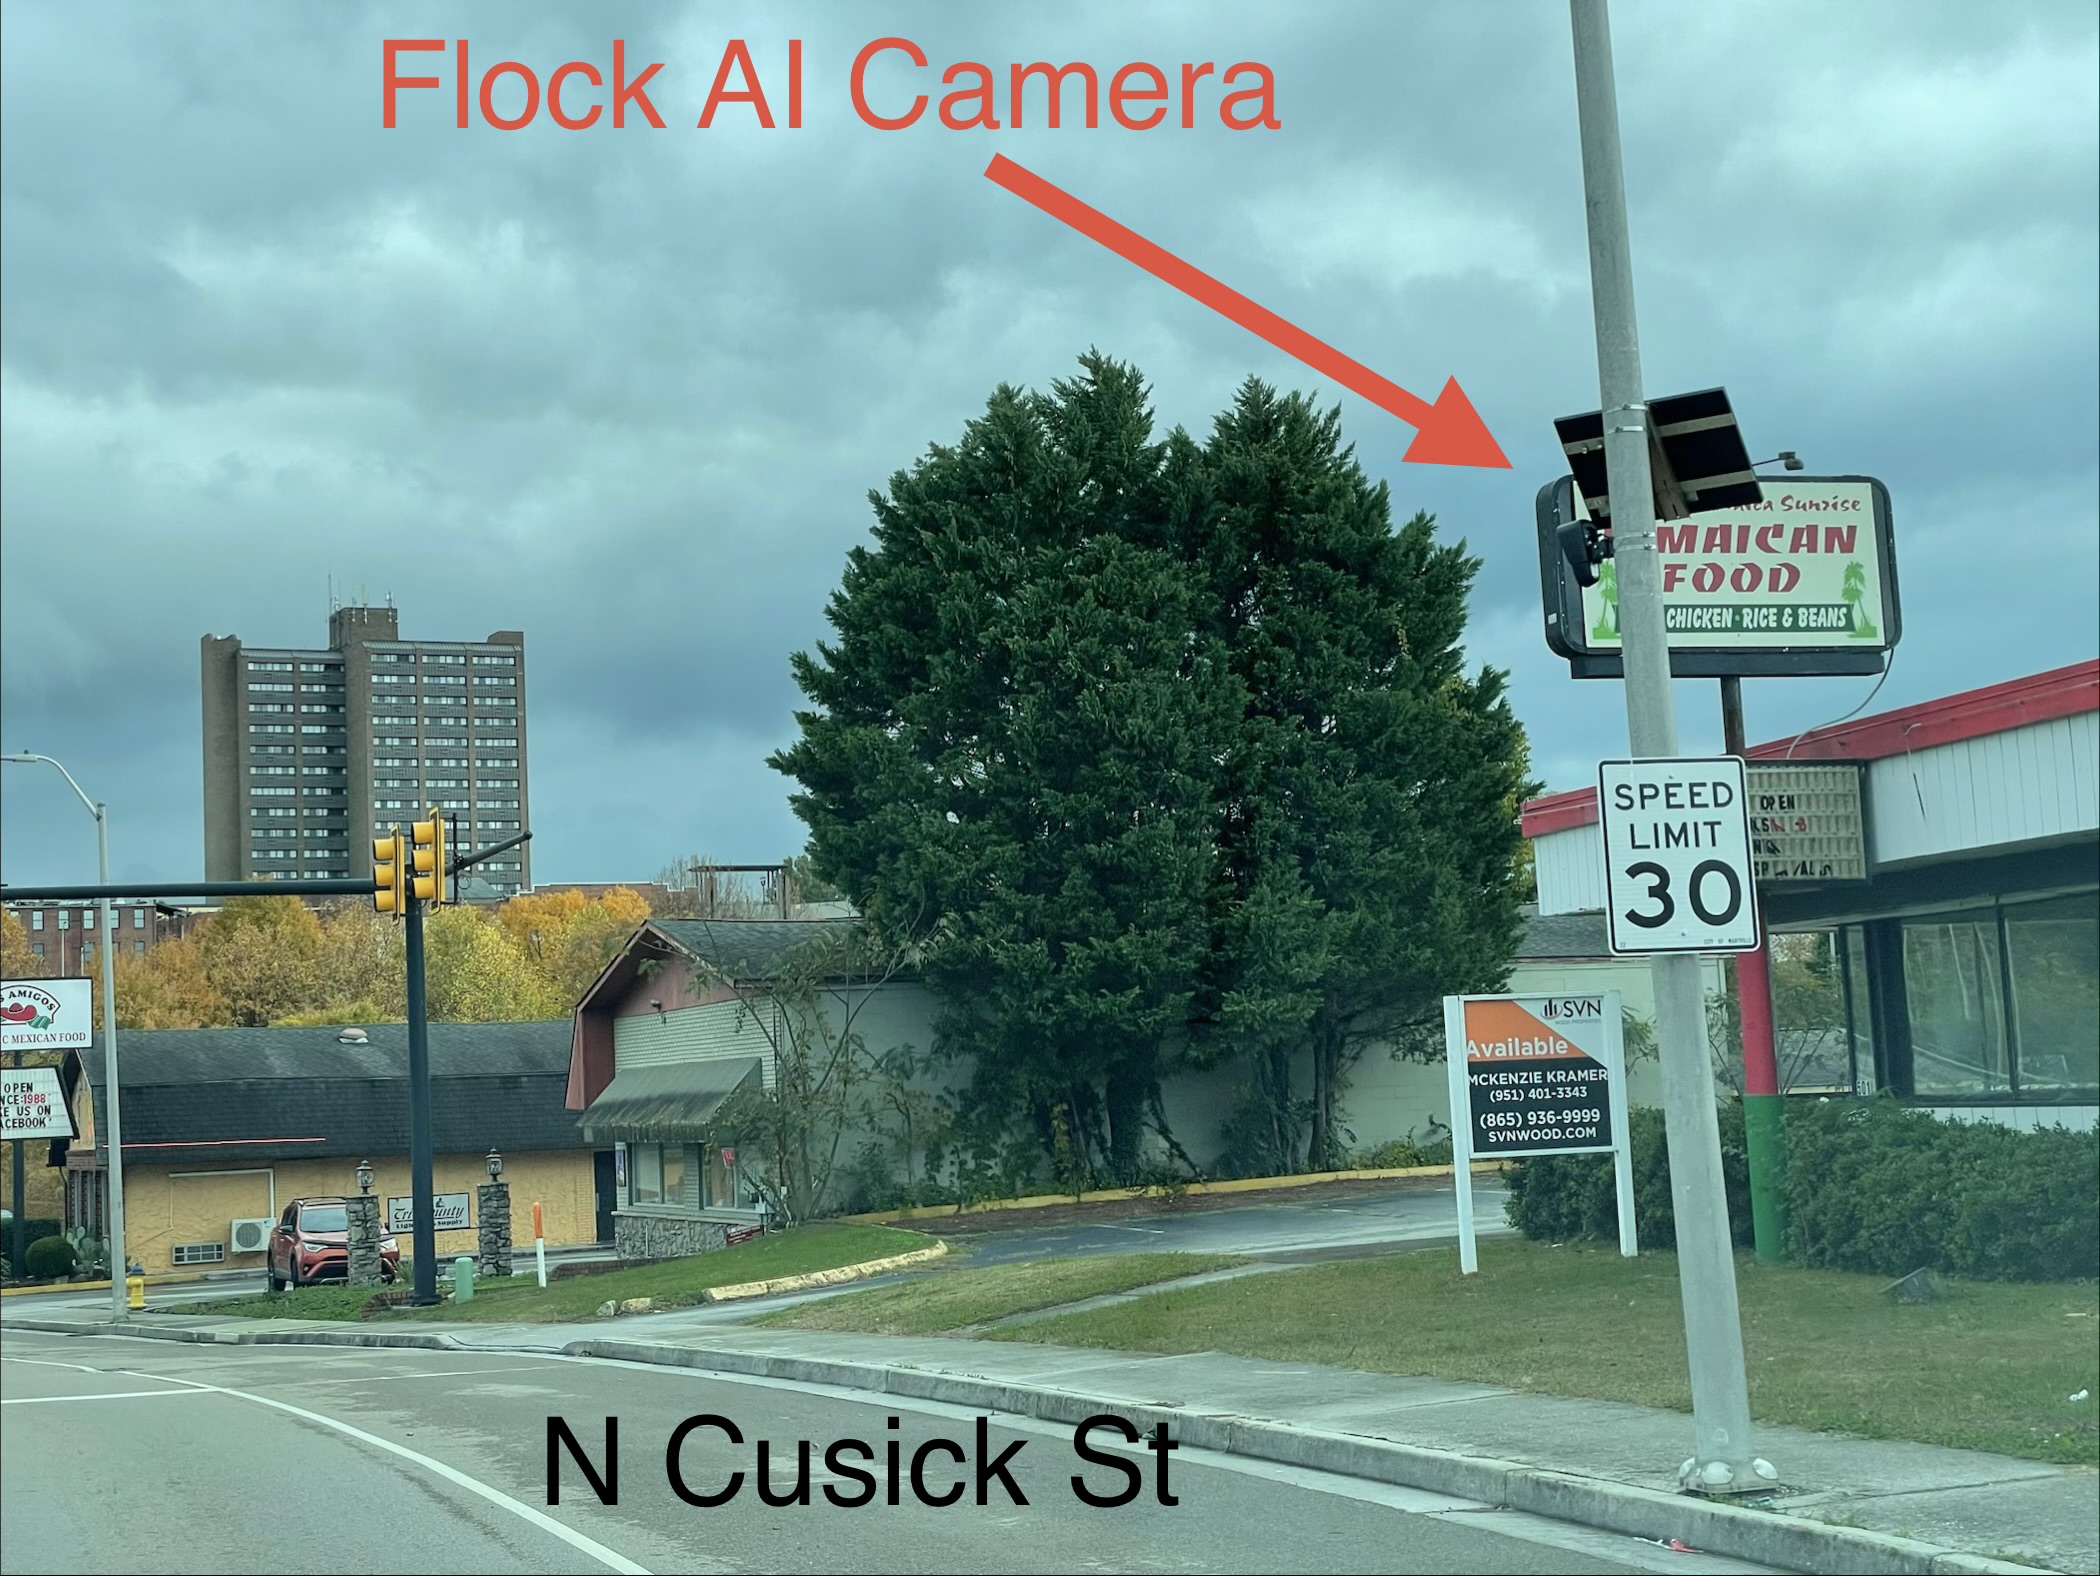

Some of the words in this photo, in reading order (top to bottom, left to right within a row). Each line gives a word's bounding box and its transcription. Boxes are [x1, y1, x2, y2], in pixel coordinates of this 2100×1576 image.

[1780, 494, 1861, 512] Sunrise
[1663, 562, 1801, 593] FOOD
[1666, 607, 1734, 629] CHICKEN
[1741, 607, 1778, 629] RICE
[1781, 607, 1793, 627] &
[1797, 607, 1847, 628] BEANS
[1614, 781, 1734, 811] SPEED
[1629, 821, 1722, 850] LIMIT
[1624, 859, 1742, 929] 30
[8, 989, 56, 1011] AMIGOS
[1563, 1000, 1602, 1018] SVN
[11, 1033, 57, 1044] MEXICAN
[60, 1032, 87, 1042] FOOD
[1467, 1036, 1568, 1058] Available
[1468, 1071, 1543, 1086] MCKENZIE
[1546, 1069, 1608, 1083] KRAMER
[4, 1082, 33, 1093] OPEN
[1489, 1089, 1525, 1103] (951)
[1528, 1086, 1588, 1100] 401-3343
[17, 1106, 31, 1116] US
[37, 1104, 52, 1116] ON
[1480, 1112, 1523, 1129] (865)
[1527, 1108, 1601, 1125] 936-9999
[1488, 1126, 1597, 1143] SVNWOOD.COM
